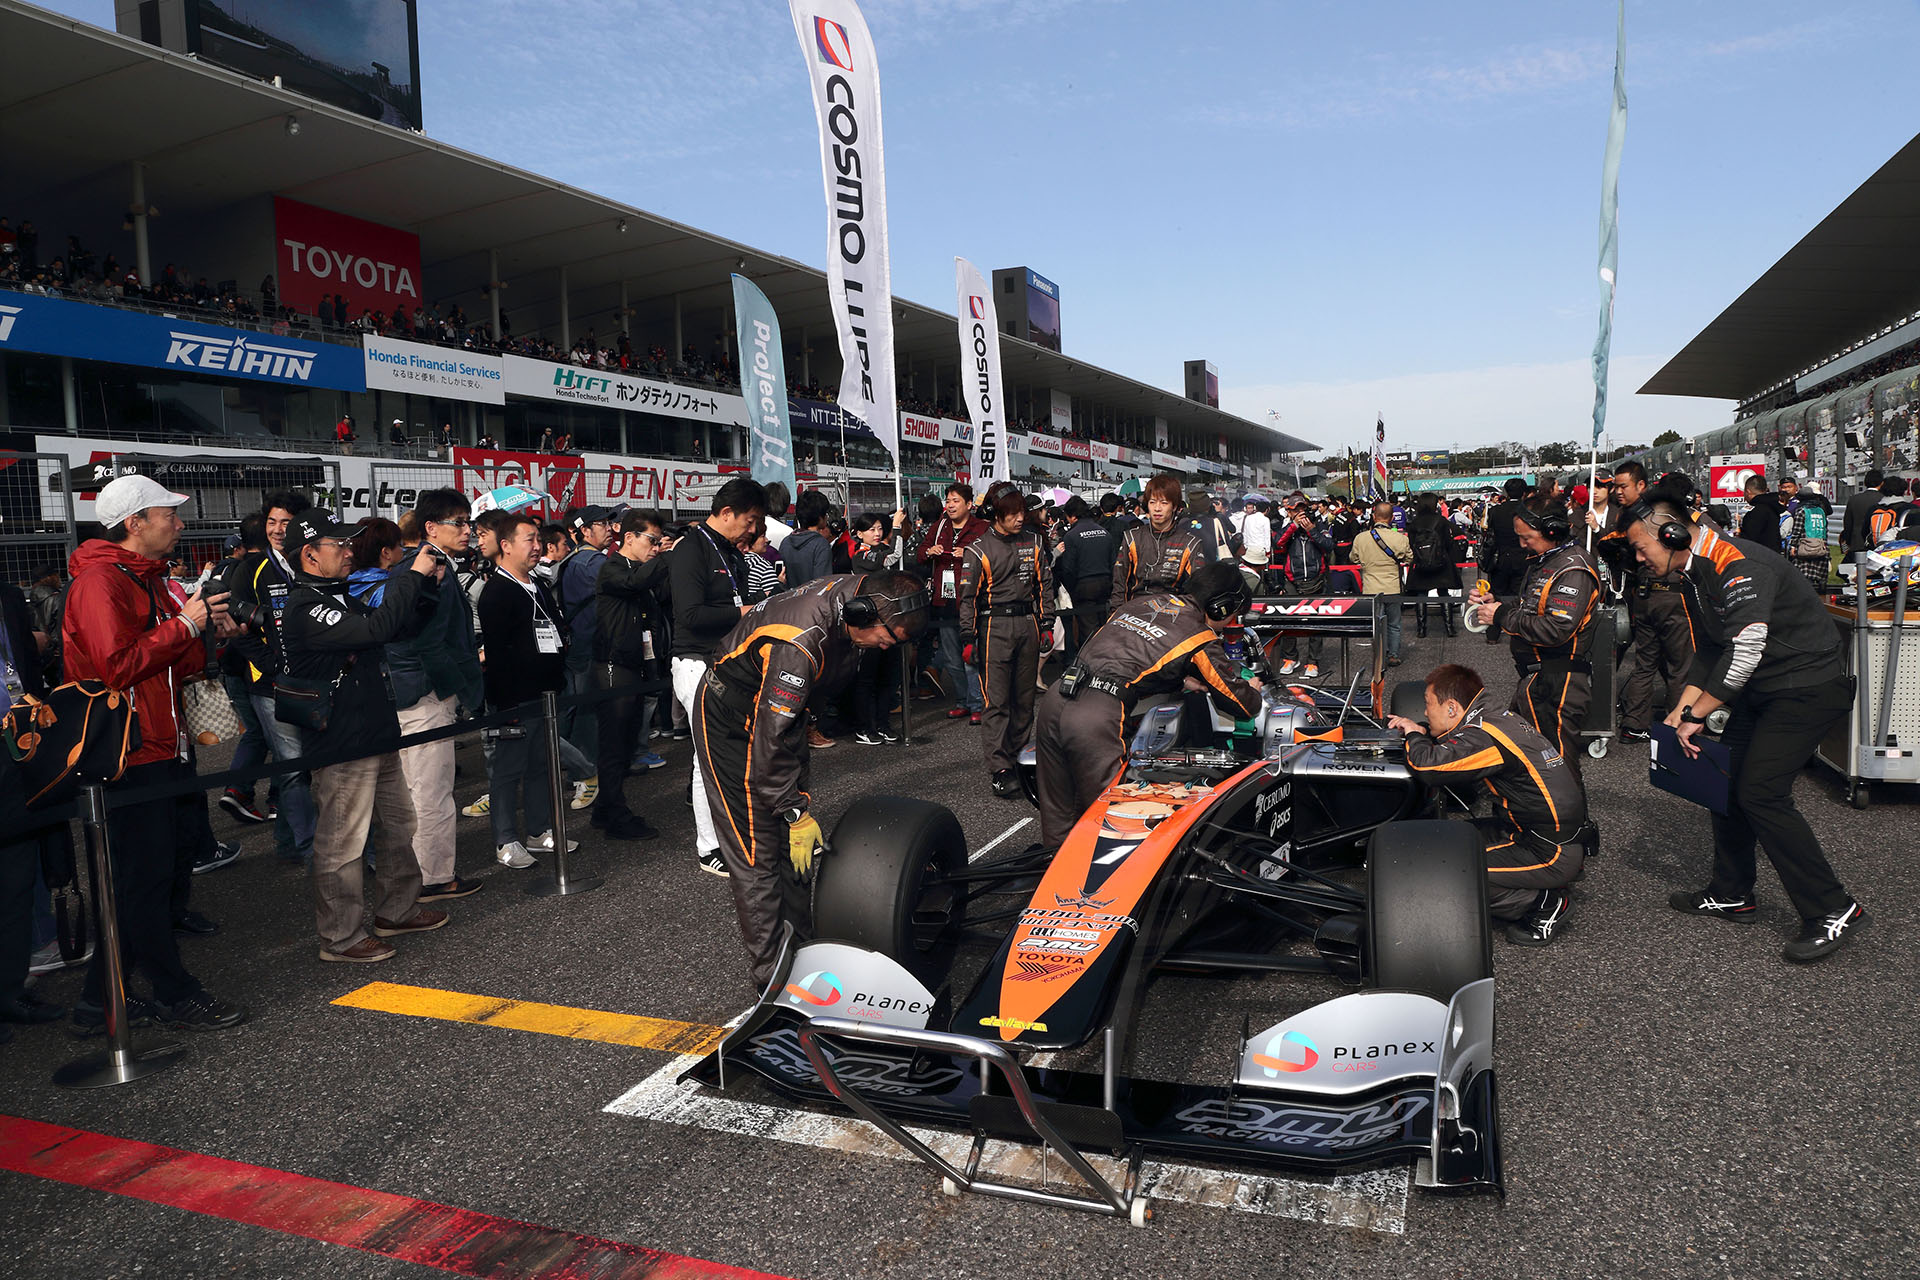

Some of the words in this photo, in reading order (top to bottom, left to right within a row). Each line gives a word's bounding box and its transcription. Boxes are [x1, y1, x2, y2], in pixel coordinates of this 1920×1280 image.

[826, 74, 866, 264] COSMO
[283, 238, 418, 299] TOYOTA
[165, 331, 318, 381] KEIHIN
[368, 348, 408, 366] Honda
[409, 355, 457, 374] Financial
[459, 363, 501, 380] Services
[753, 319, 781, 428] project
[972, 322, 992, 414] COSMO
[552, 367, 612, 393] HTFT
[555, 388, 576, 399] Honda
[616, 382, 719, 415] ホンダテクノフォート
[904, 417, 940, 440] SHOWA
[978, 420, 996, 479] LUBE
[1030, 436, 1060, 452] Modulo
[1064, 443, 1089, 457] Modulo
[170, 463, 218, 474] CERUMO
[461, 457, 558, 512] NGK
[606, 464, 703, 502] DENSO
[1442, 481, 1475, 490] SUZUKA
[1475, 479, 1507, 488] CIRCUIT
[1716, 468, 1757, 493] 40
[1264, 605, 1342, 615] DVAN
[1119, 613, 1168, 639] INGING
[772, 685, 801, 703] TOYOTA
[1322, 763, 1386, 772] ROWEN
[1262, 781, 1291, 813] CERUMO
[1091, 844, 1139, 865] 1
[1055, 929, 1097, 940] HOMES
[1018, 951, 1085, 965] TOYOTA
[1042, 966, 1085, 984] YOKOHAMA
[846, 1006, 884, 1020] CARS
[979, 1015, 1048, 1033] dallara
[1331, 1060, 1378, 1073] CARS
[853, 1080, 924, 1096] PADS
[1180, 1122, 1315, 1146] RACING
[1315, 1126, 1401, 1149] PADS
